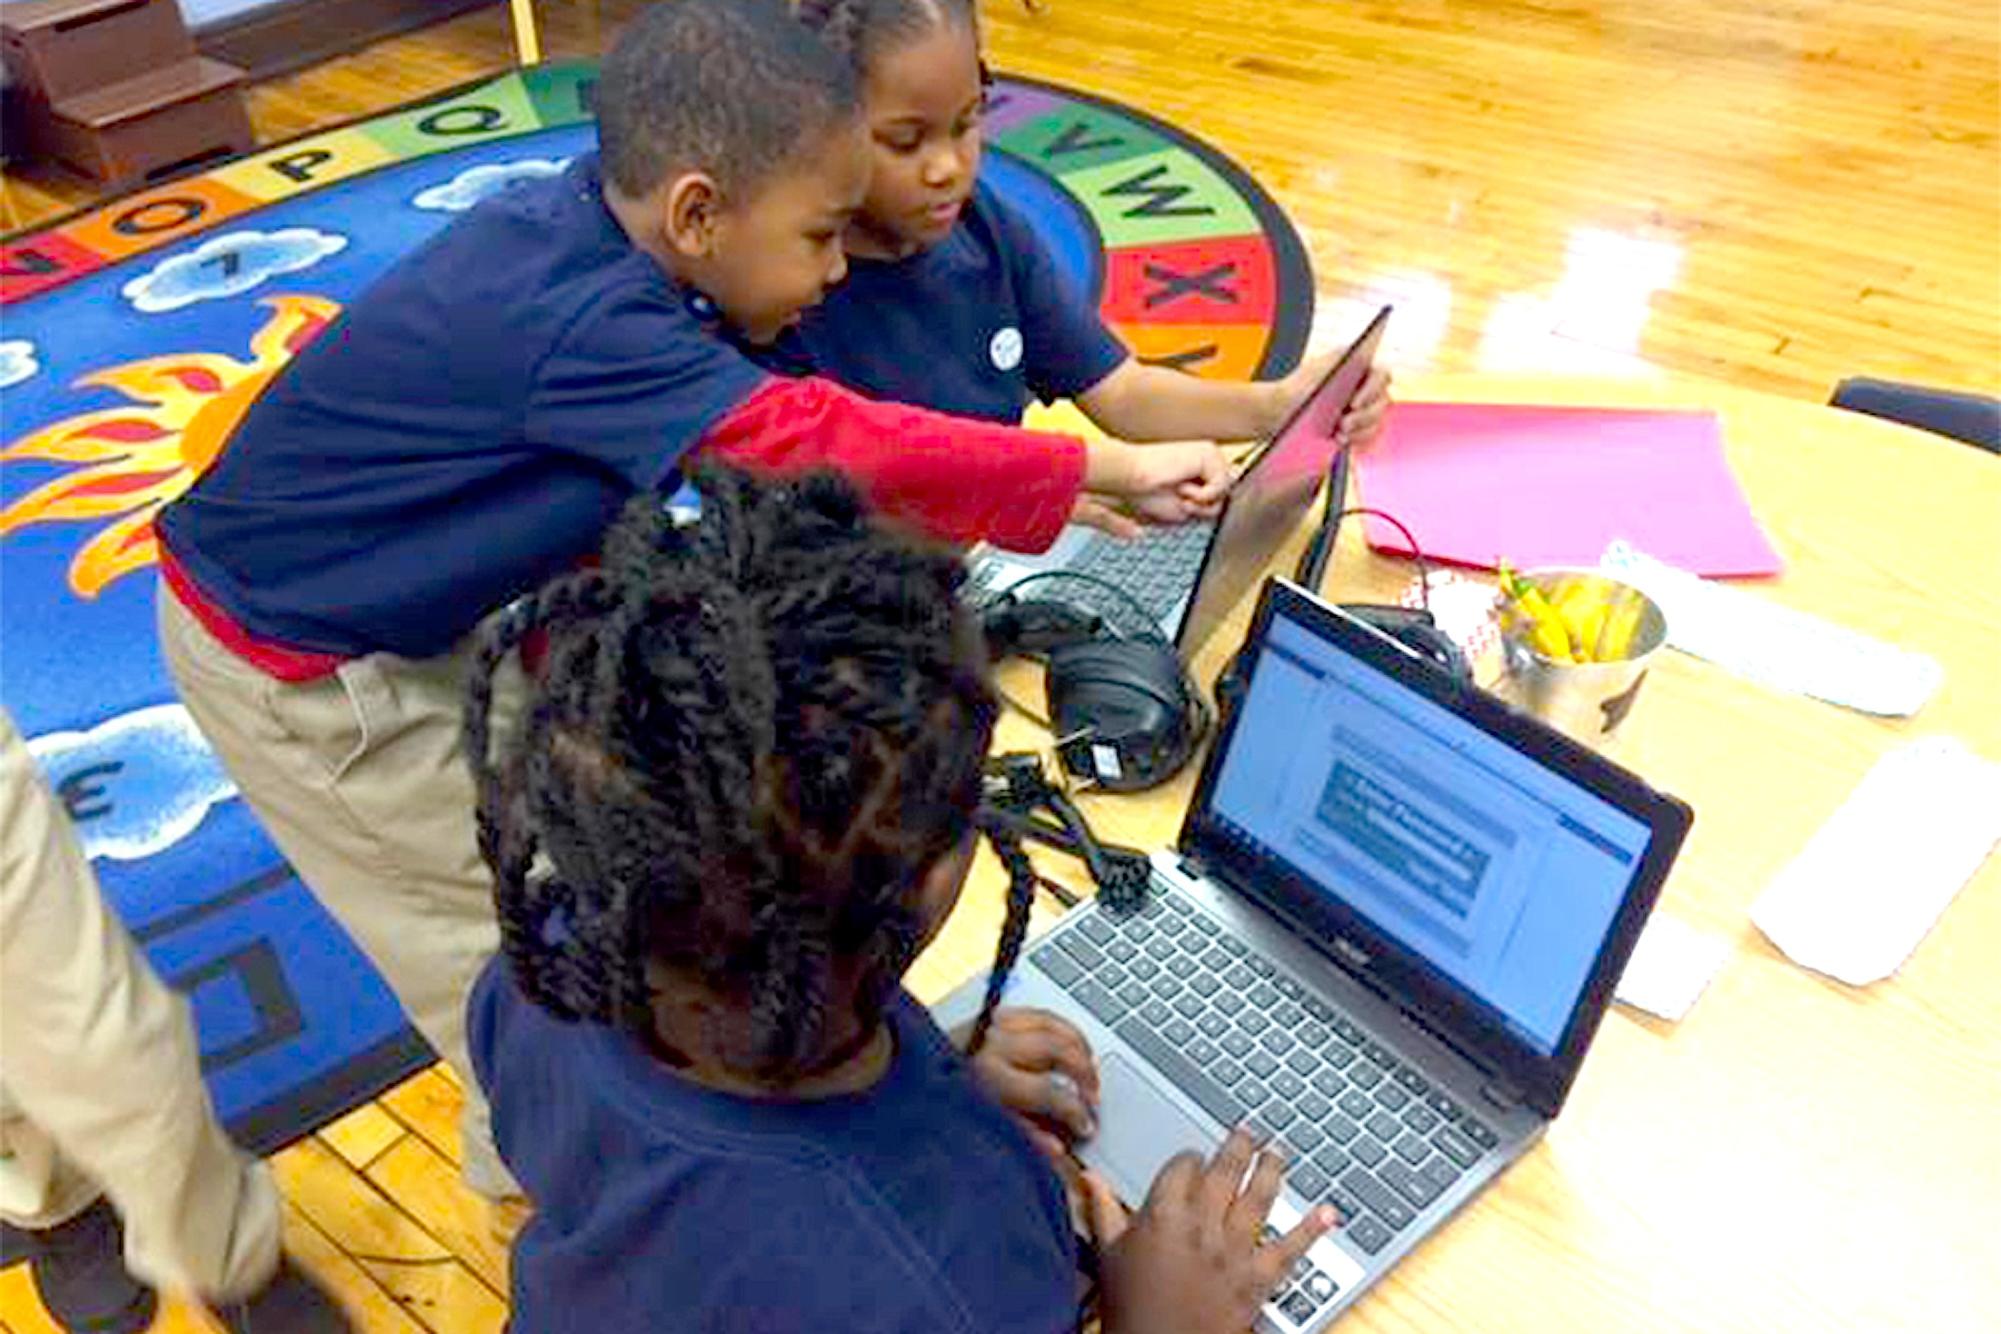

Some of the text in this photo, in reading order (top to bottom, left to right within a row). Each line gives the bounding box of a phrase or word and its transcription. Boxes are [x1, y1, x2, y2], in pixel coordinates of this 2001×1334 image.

[111, 197, 206, 235] O
[269, 149, 330, 182] P
[417, 105, 509, 135] Q
[1042, 124, 1238, 378] V W X Y
